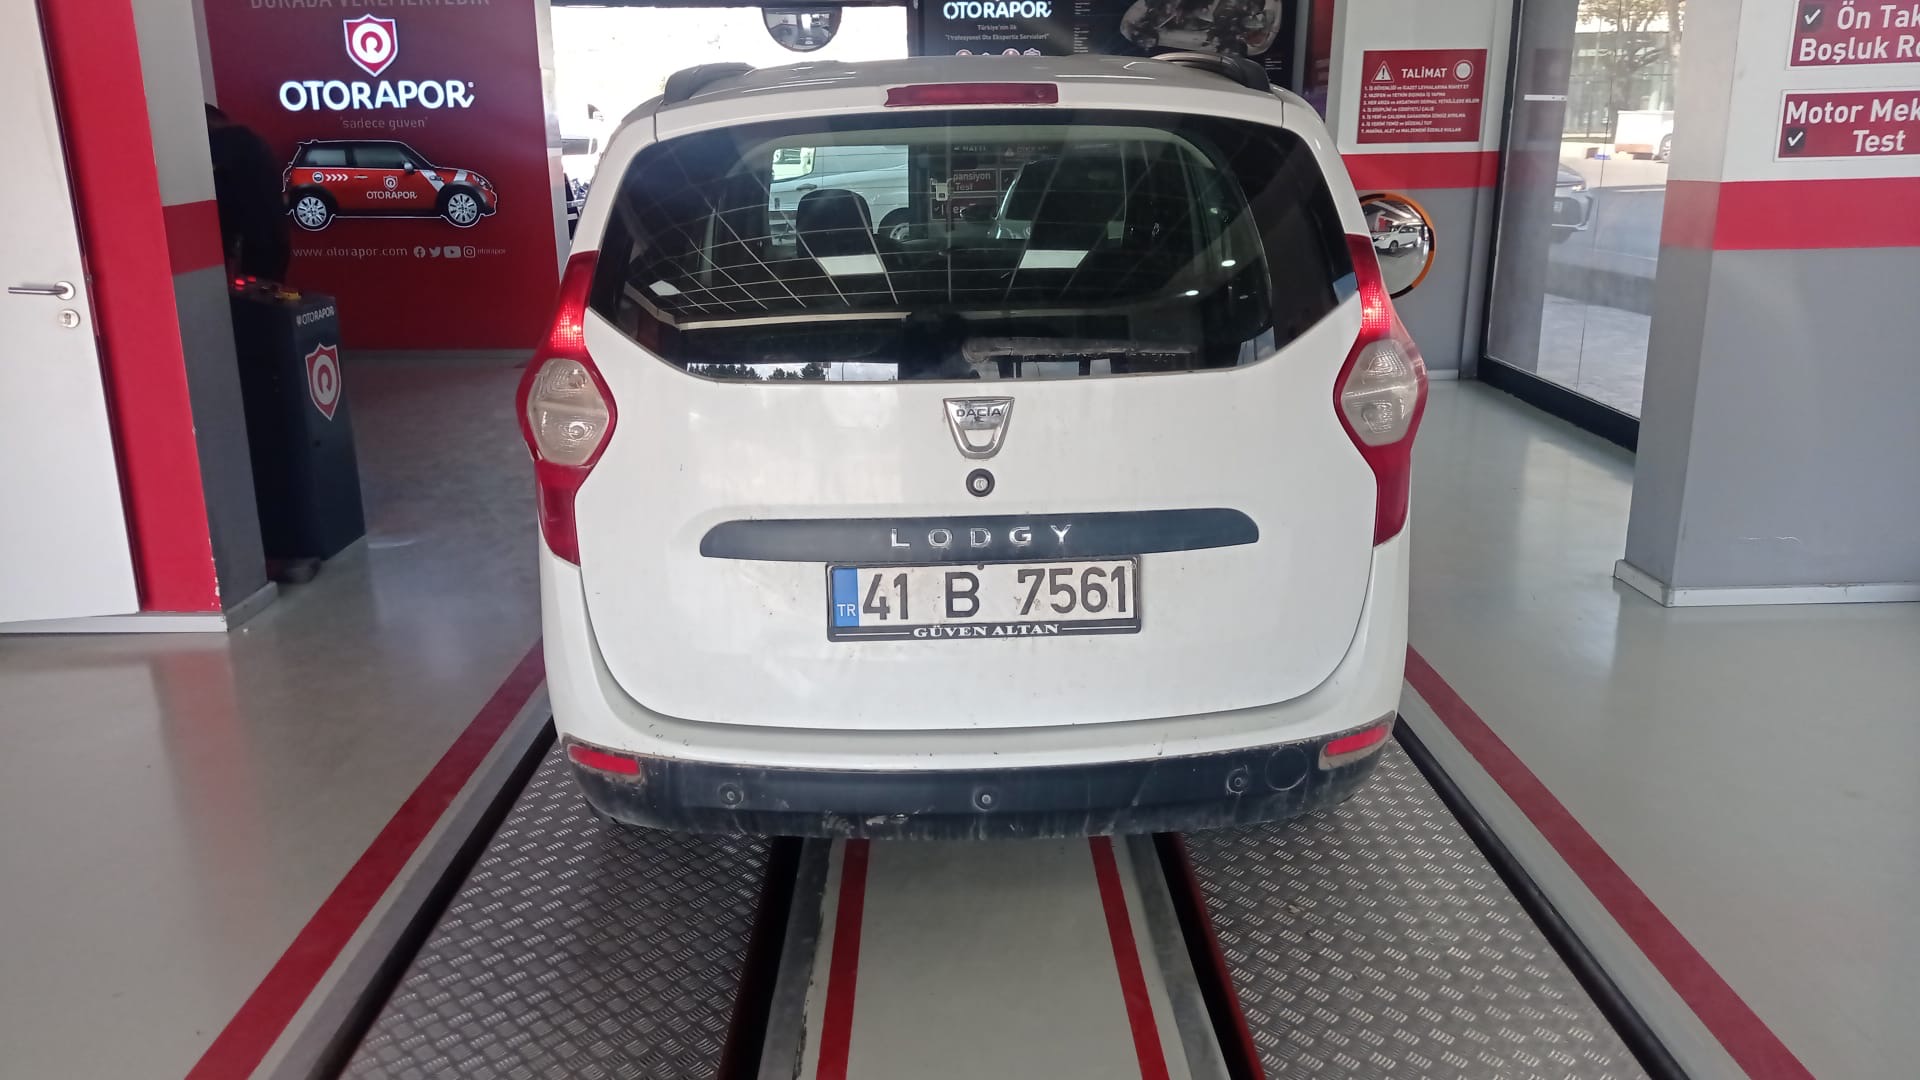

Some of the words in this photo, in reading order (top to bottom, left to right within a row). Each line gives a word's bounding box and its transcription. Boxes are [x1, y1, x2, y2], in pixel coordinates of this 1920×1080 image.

[943, 1, 1052, 20] OTORAPOR
[1837, 0, 1871, 30] Ön
[1799, 36, 1890, 63] Boşluk
[1401, 66, 1448, 79] TALİMAT
[279, 80, 475, 111] OTORAPOR
[1786, 101, 1864, 124] Motor
[1869, 98, 1920, 122] Mek
[1853, 129, 1906, 153] Test
[366, 191, 418, 200] OTORAPOR
[293, 246, 408, 259] www.otorapor.com
[956, 407, 1002, 418] DACIA
[891, 524, 1072, 548] LODGY
[837, 603, 857, 617] TR
[862, 572, 909, 621] 41
[944, 571, 981, 619] B
[1016, 565, 1127, 616] 7561
[913, 625, 989, 638] GÜVEN
[991, 623, 1060, 636] ALTAN
